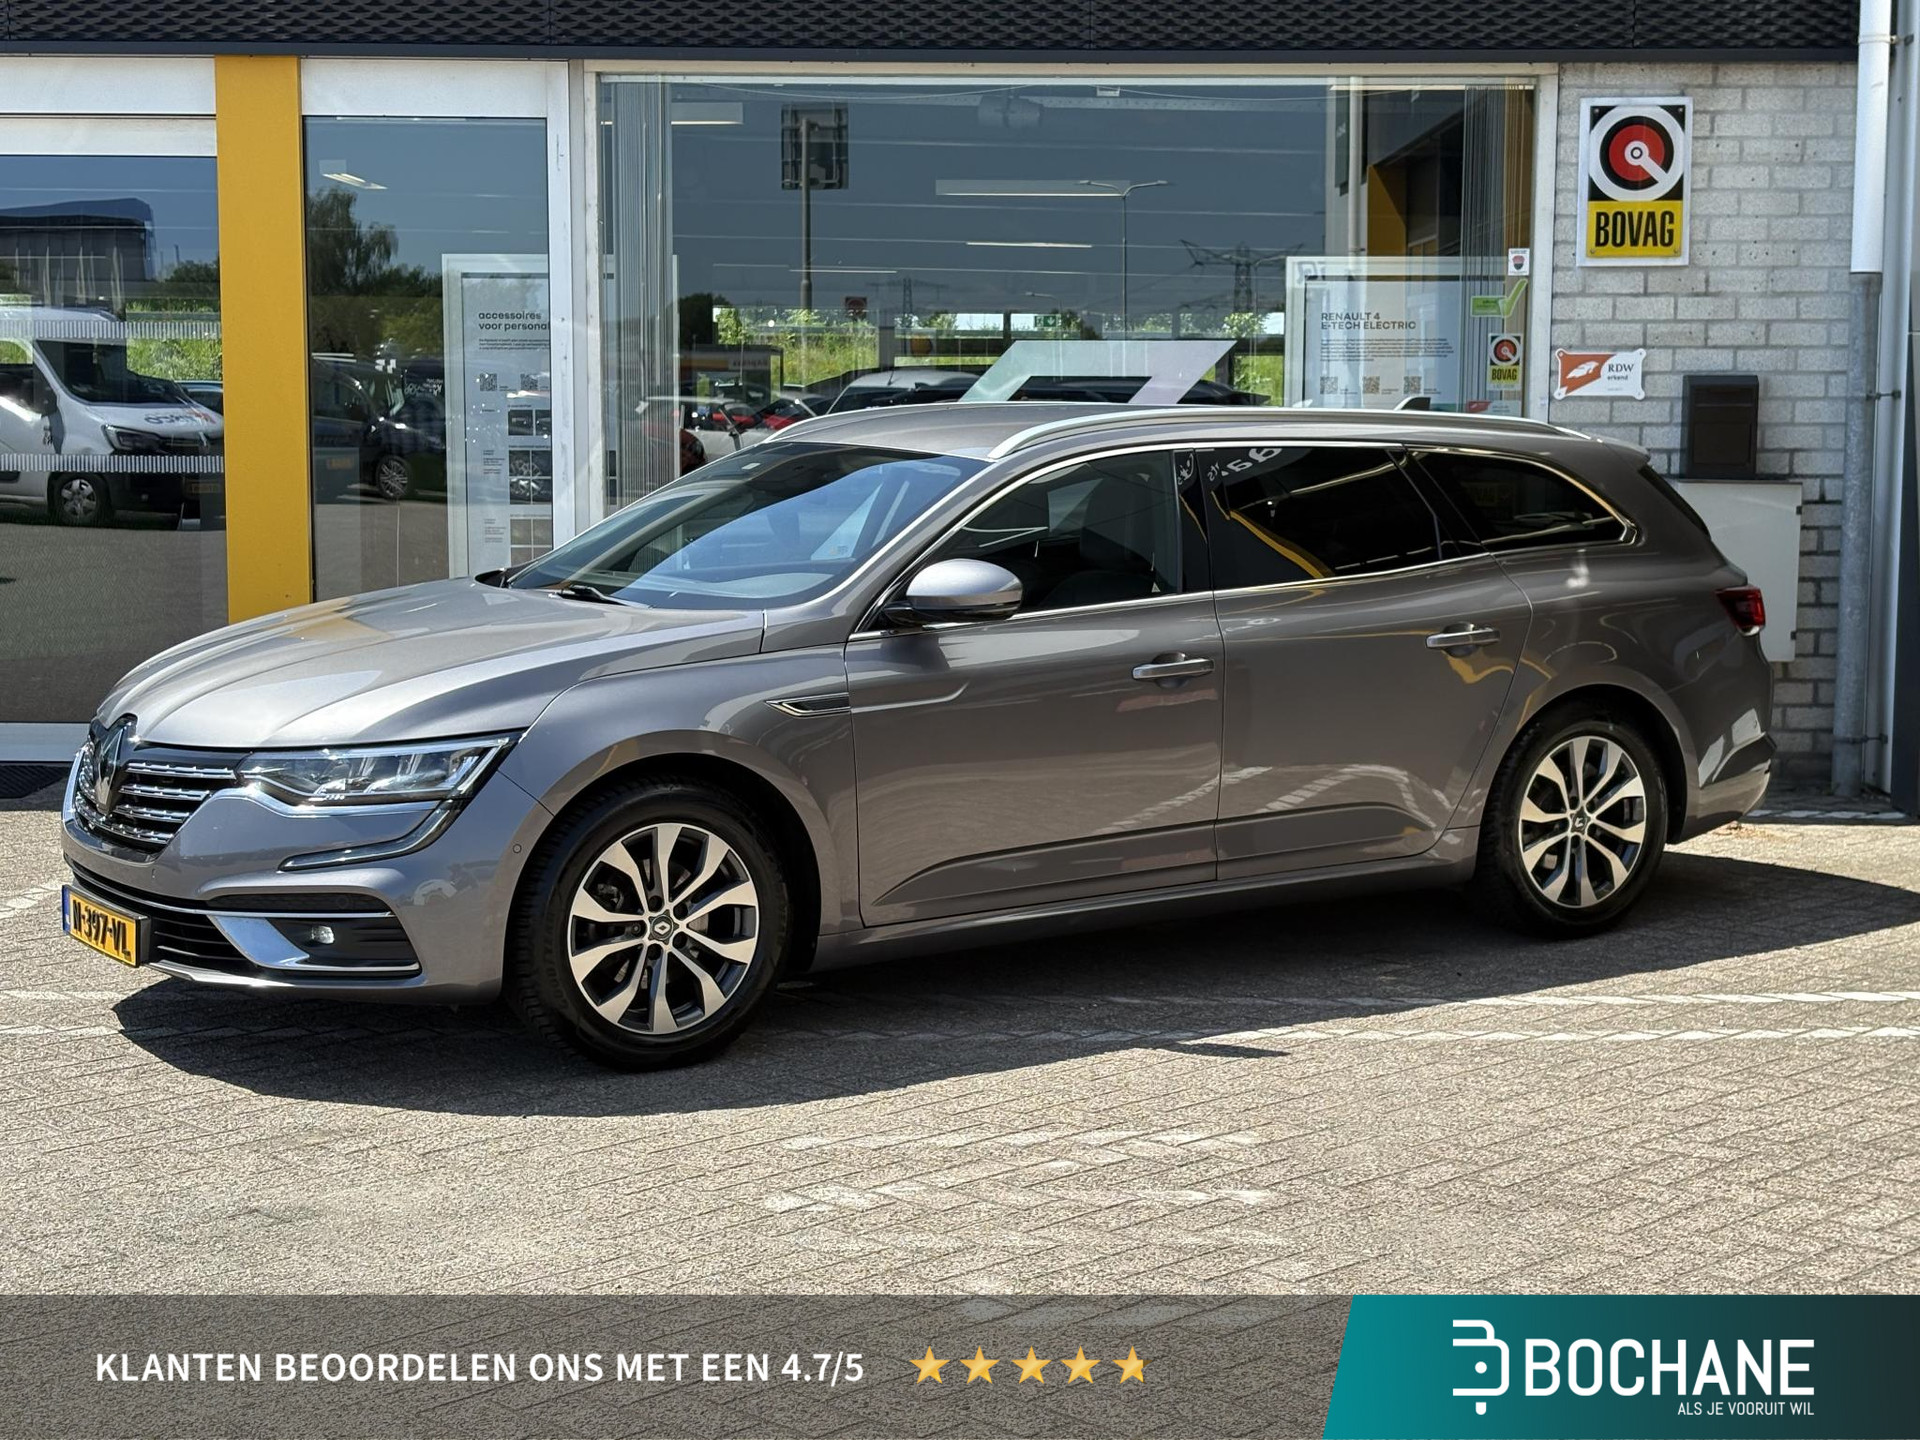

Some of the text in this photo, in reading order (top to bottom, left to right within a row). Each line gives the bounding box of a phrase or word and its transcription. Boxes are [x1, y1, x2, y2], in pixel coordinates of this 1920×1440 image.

[1594, 210, 1675, 248] BOVAG
[478, 310, 542, 320] accessoires
[1321, 312, 1381, 321] RENAULT 4
[478, 322, 503, 331] voor
[1321, 321, 1417, 330] E-TECH ELECTRIC
[1608, 363, 1634, 372] RDW
[1491, 368, 1518, 381] BOVAG
[72, 899, 132, 957] N-397-VL
